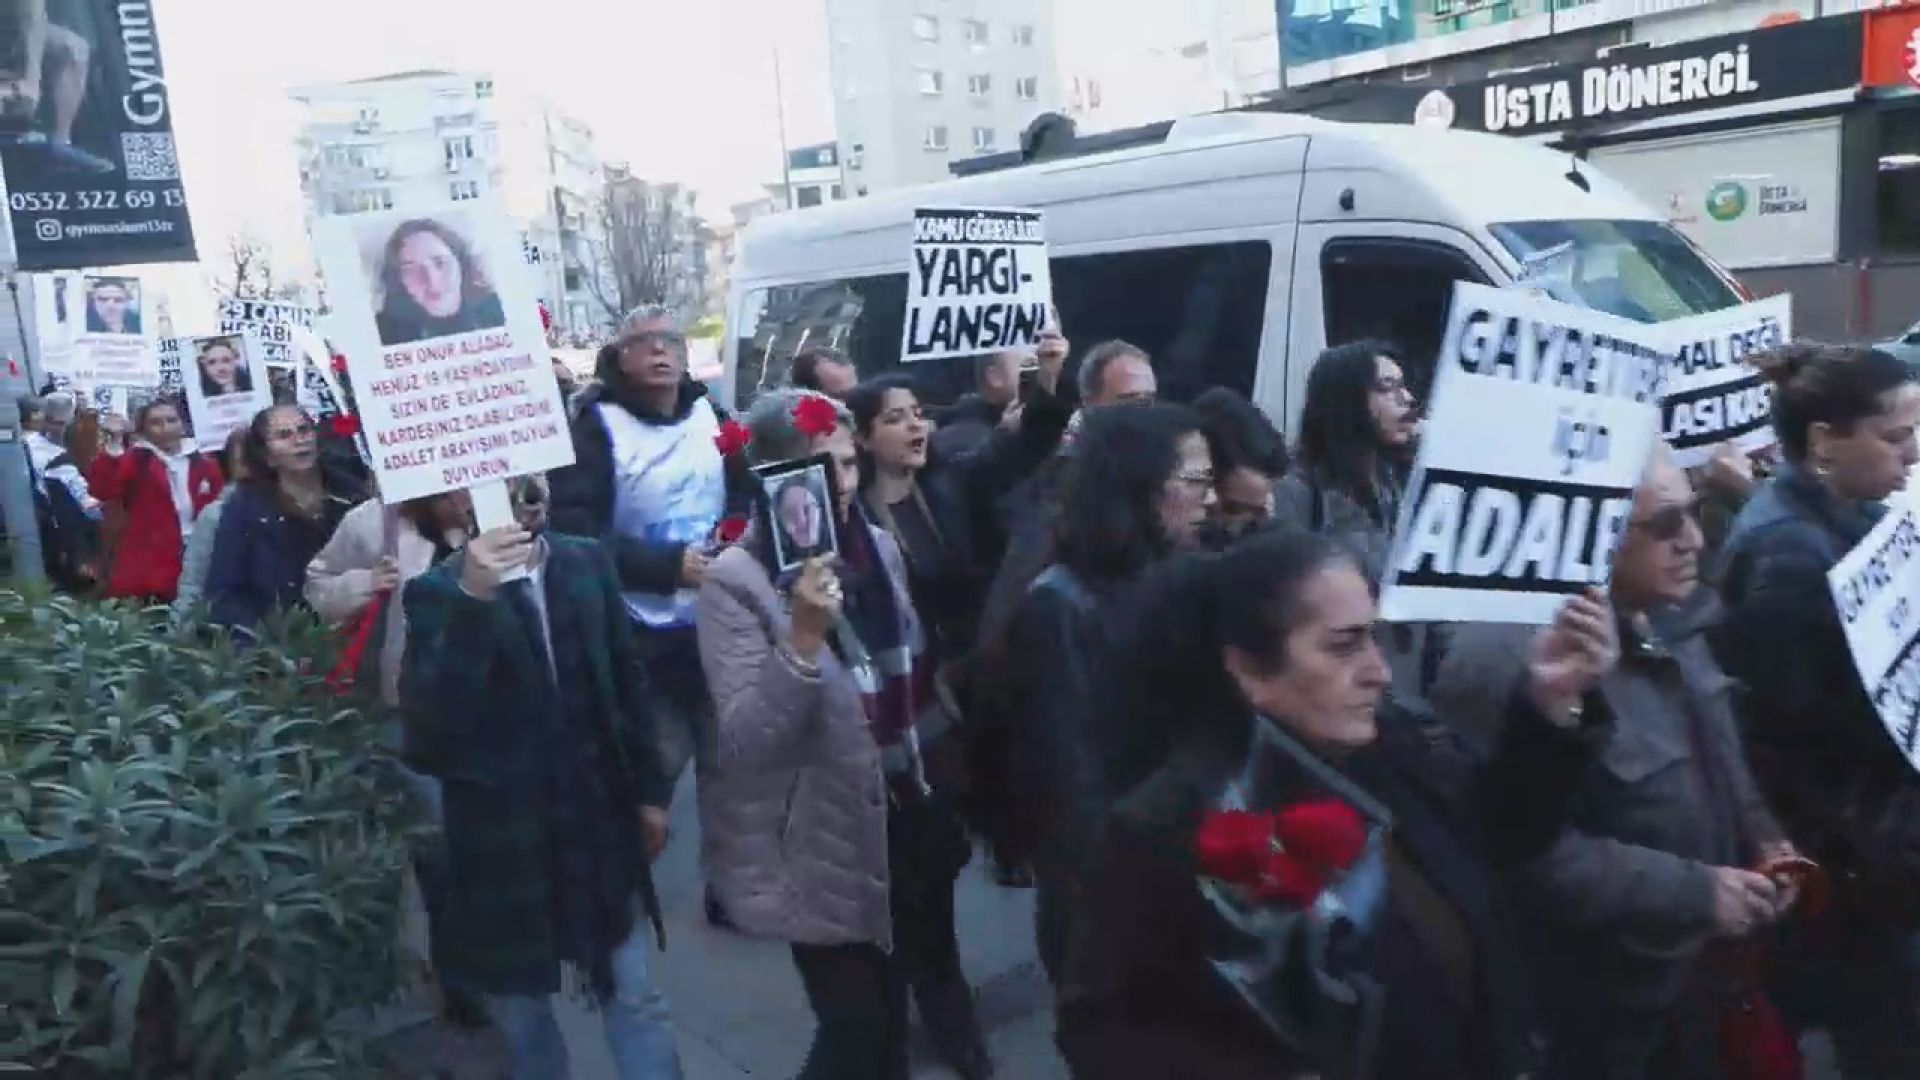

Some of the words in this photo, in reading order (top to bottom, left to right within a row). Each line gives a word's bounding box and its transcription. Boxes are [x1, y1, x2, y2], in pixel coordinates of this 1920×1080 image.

[117, 2, 165, 124] Gymn
[1484, 80, 1573, 131] USTA
[10, 191, 70, 211] 0532
[76, 190, 120, 209] 322
[125, 189, 155, 208] 69
[162, 188, 184, 207] 13
[914, 247, 1033, 298] YARGI-
[907, 302, 1046, 355] LANSIN!
[416, 344, 456, 363] ONUR
[431, 395, 450, 412] DE
[383, 447, 436, 470] ADALET
[511, 423, 558, 445] DUYUN
[442, 458, 510, 484] DUYURUN
